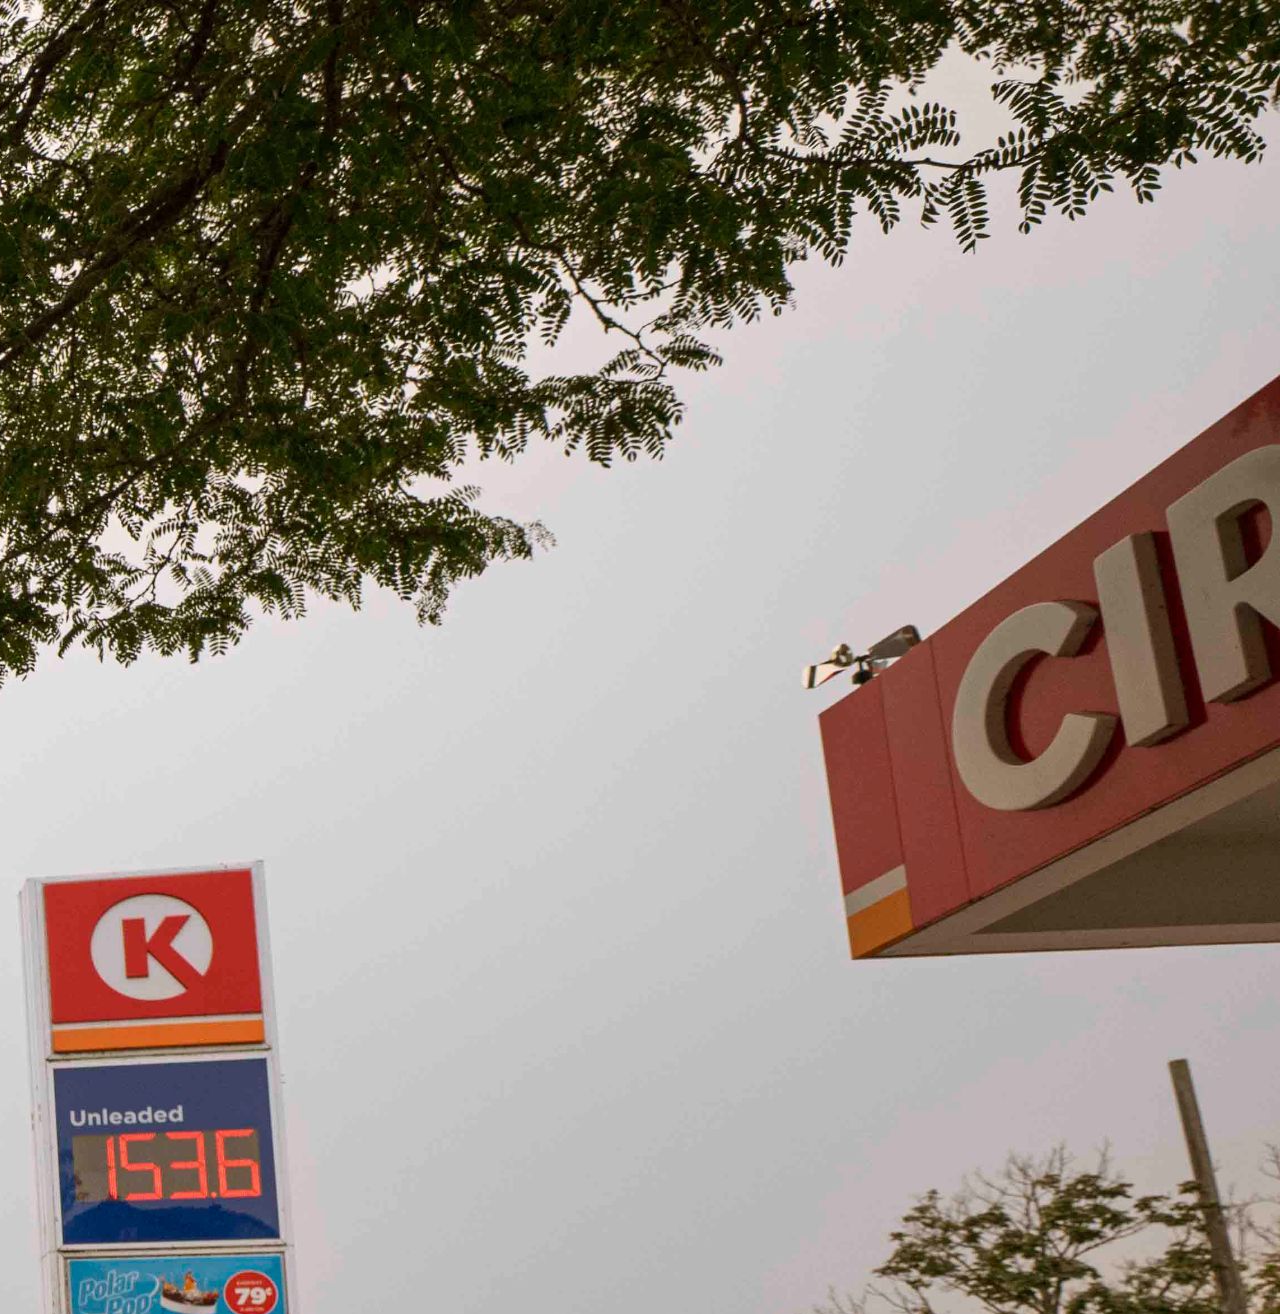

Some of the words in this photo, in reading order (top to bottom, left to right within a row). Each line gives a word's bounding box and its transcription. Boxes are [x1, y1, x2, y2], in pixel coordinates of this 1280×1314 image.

[70, 1105, 184, 1127] Unleaded
[106, 1129, 262, 1201] 153.6
[79, 1269, 140, 1306] Polar
